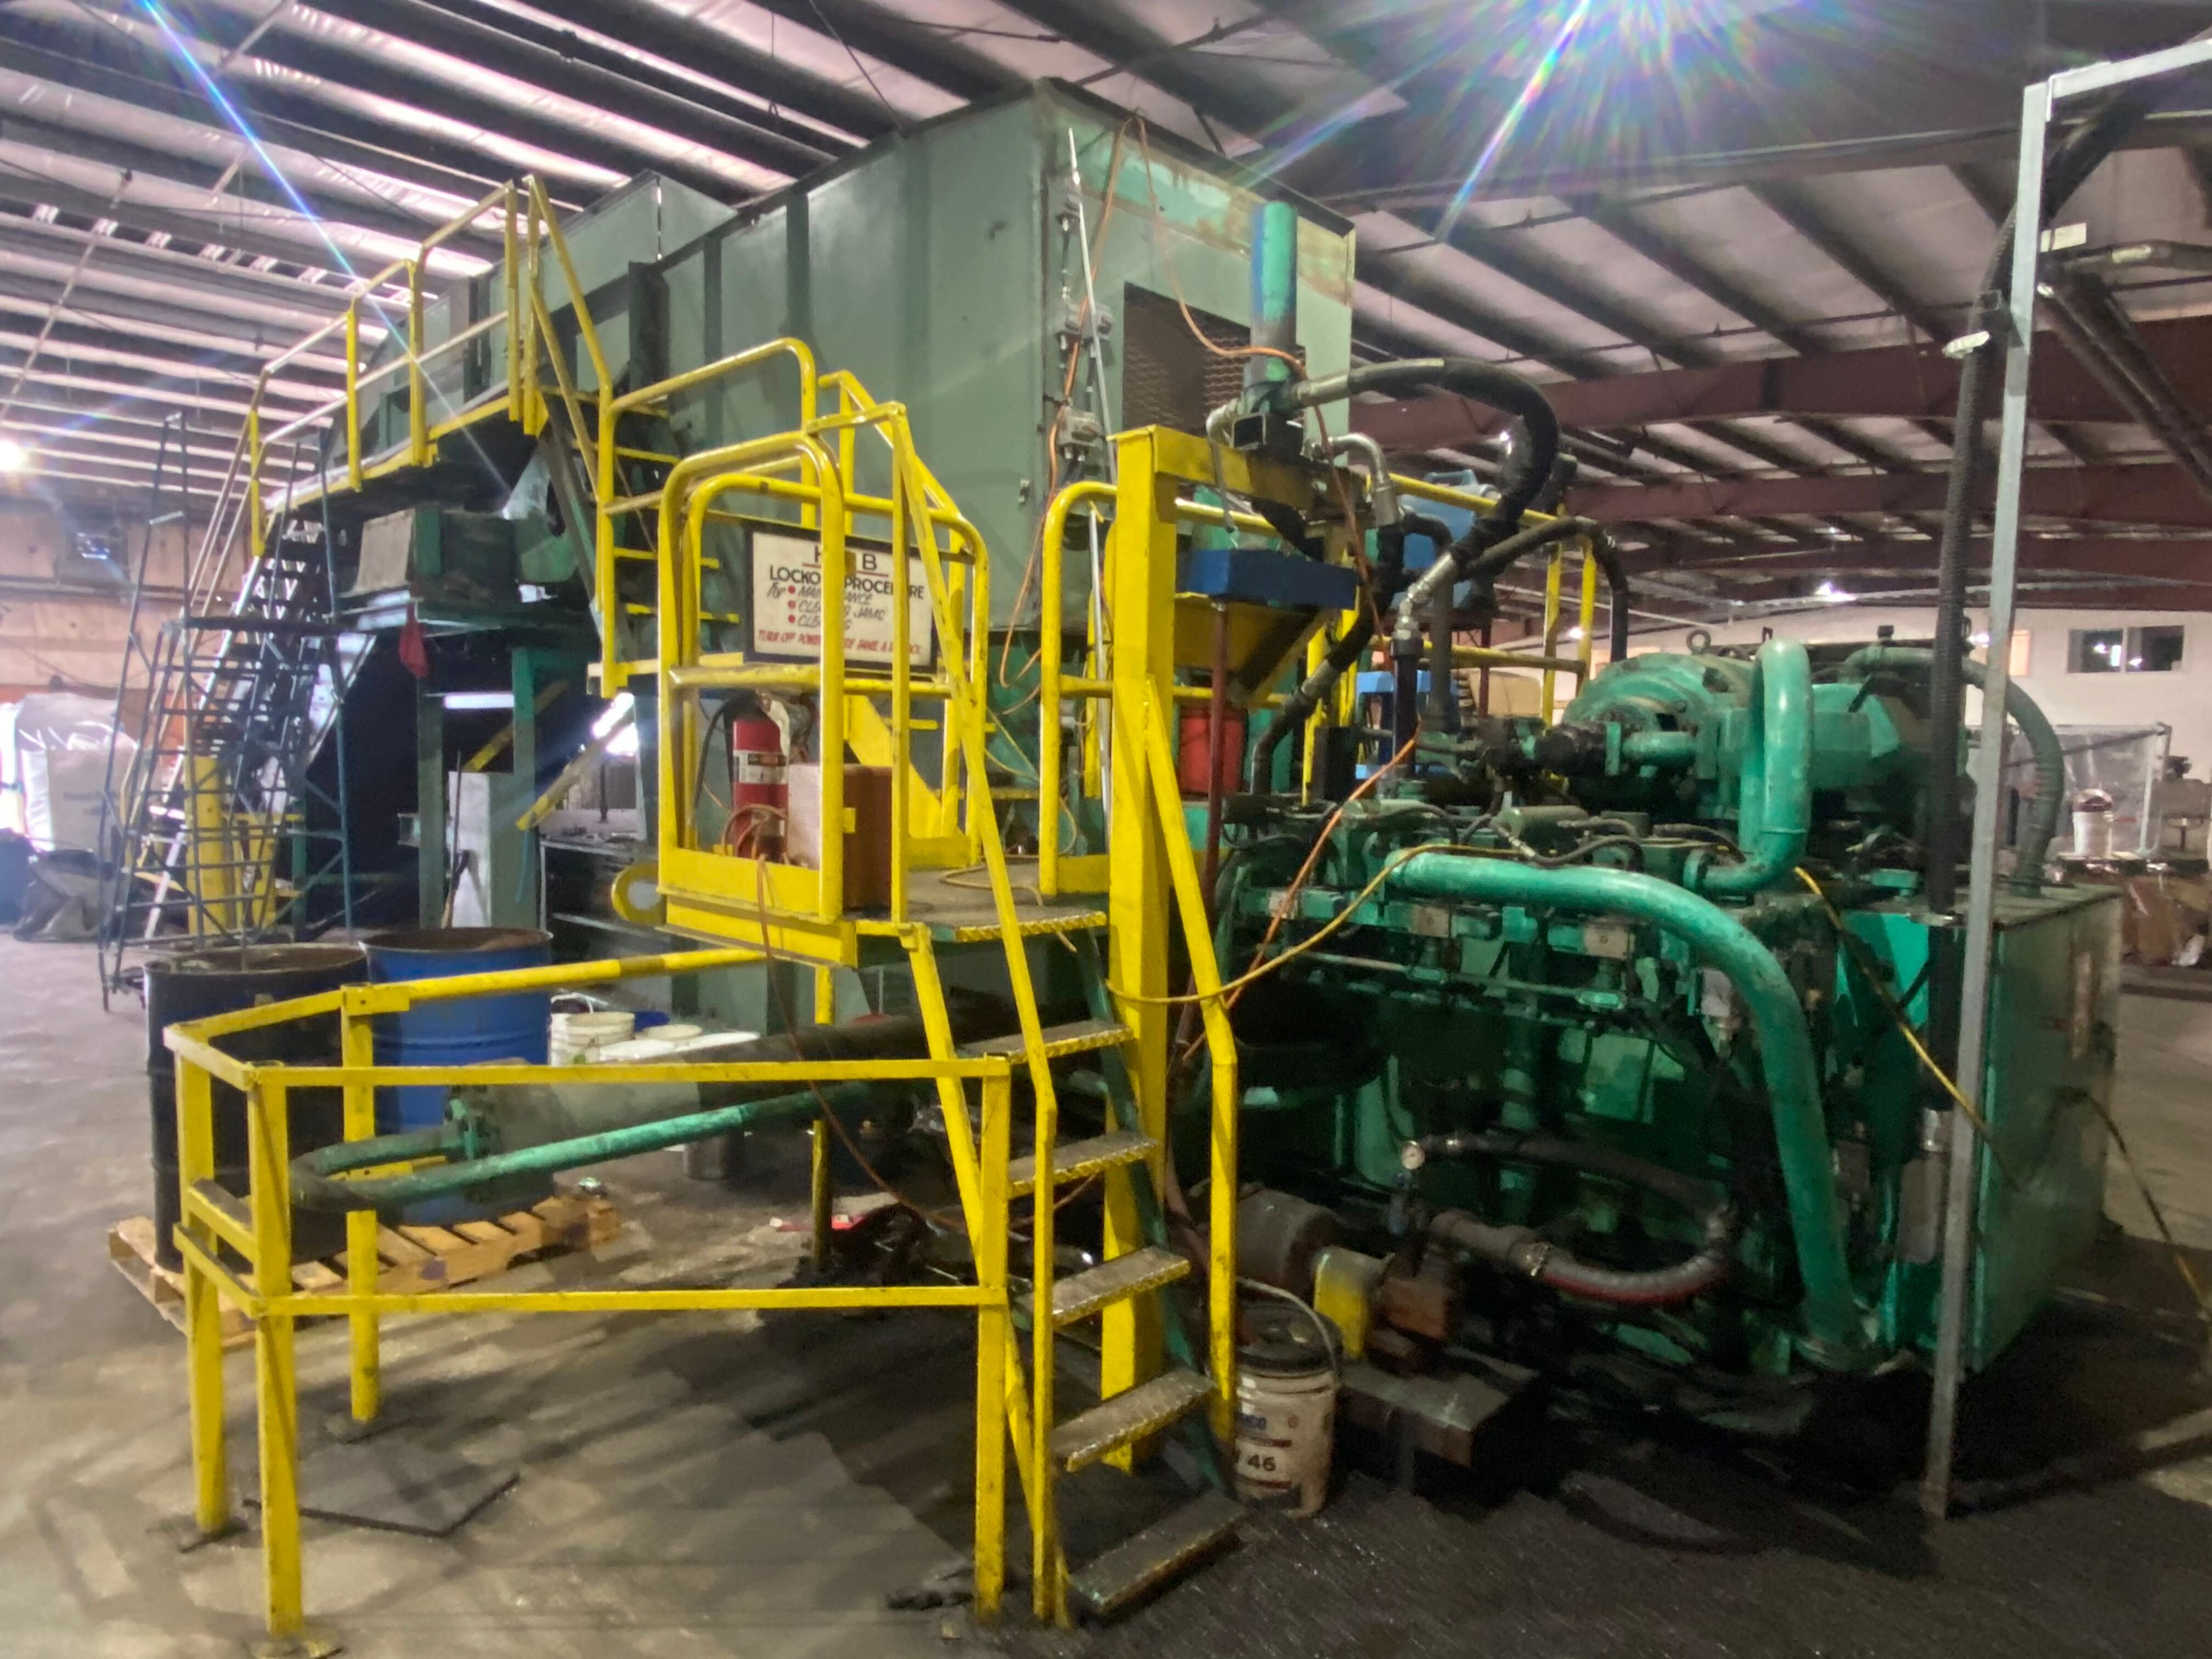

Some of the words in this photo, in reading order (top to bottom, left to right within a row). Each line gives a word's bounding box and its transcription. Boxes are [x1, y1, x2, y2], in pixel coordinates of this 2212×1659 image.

[770, 565, 821, 585] LOCKO
[844, 576, 924, 599] PROCERE
[1247, 1454, 1276, 1472] 46
